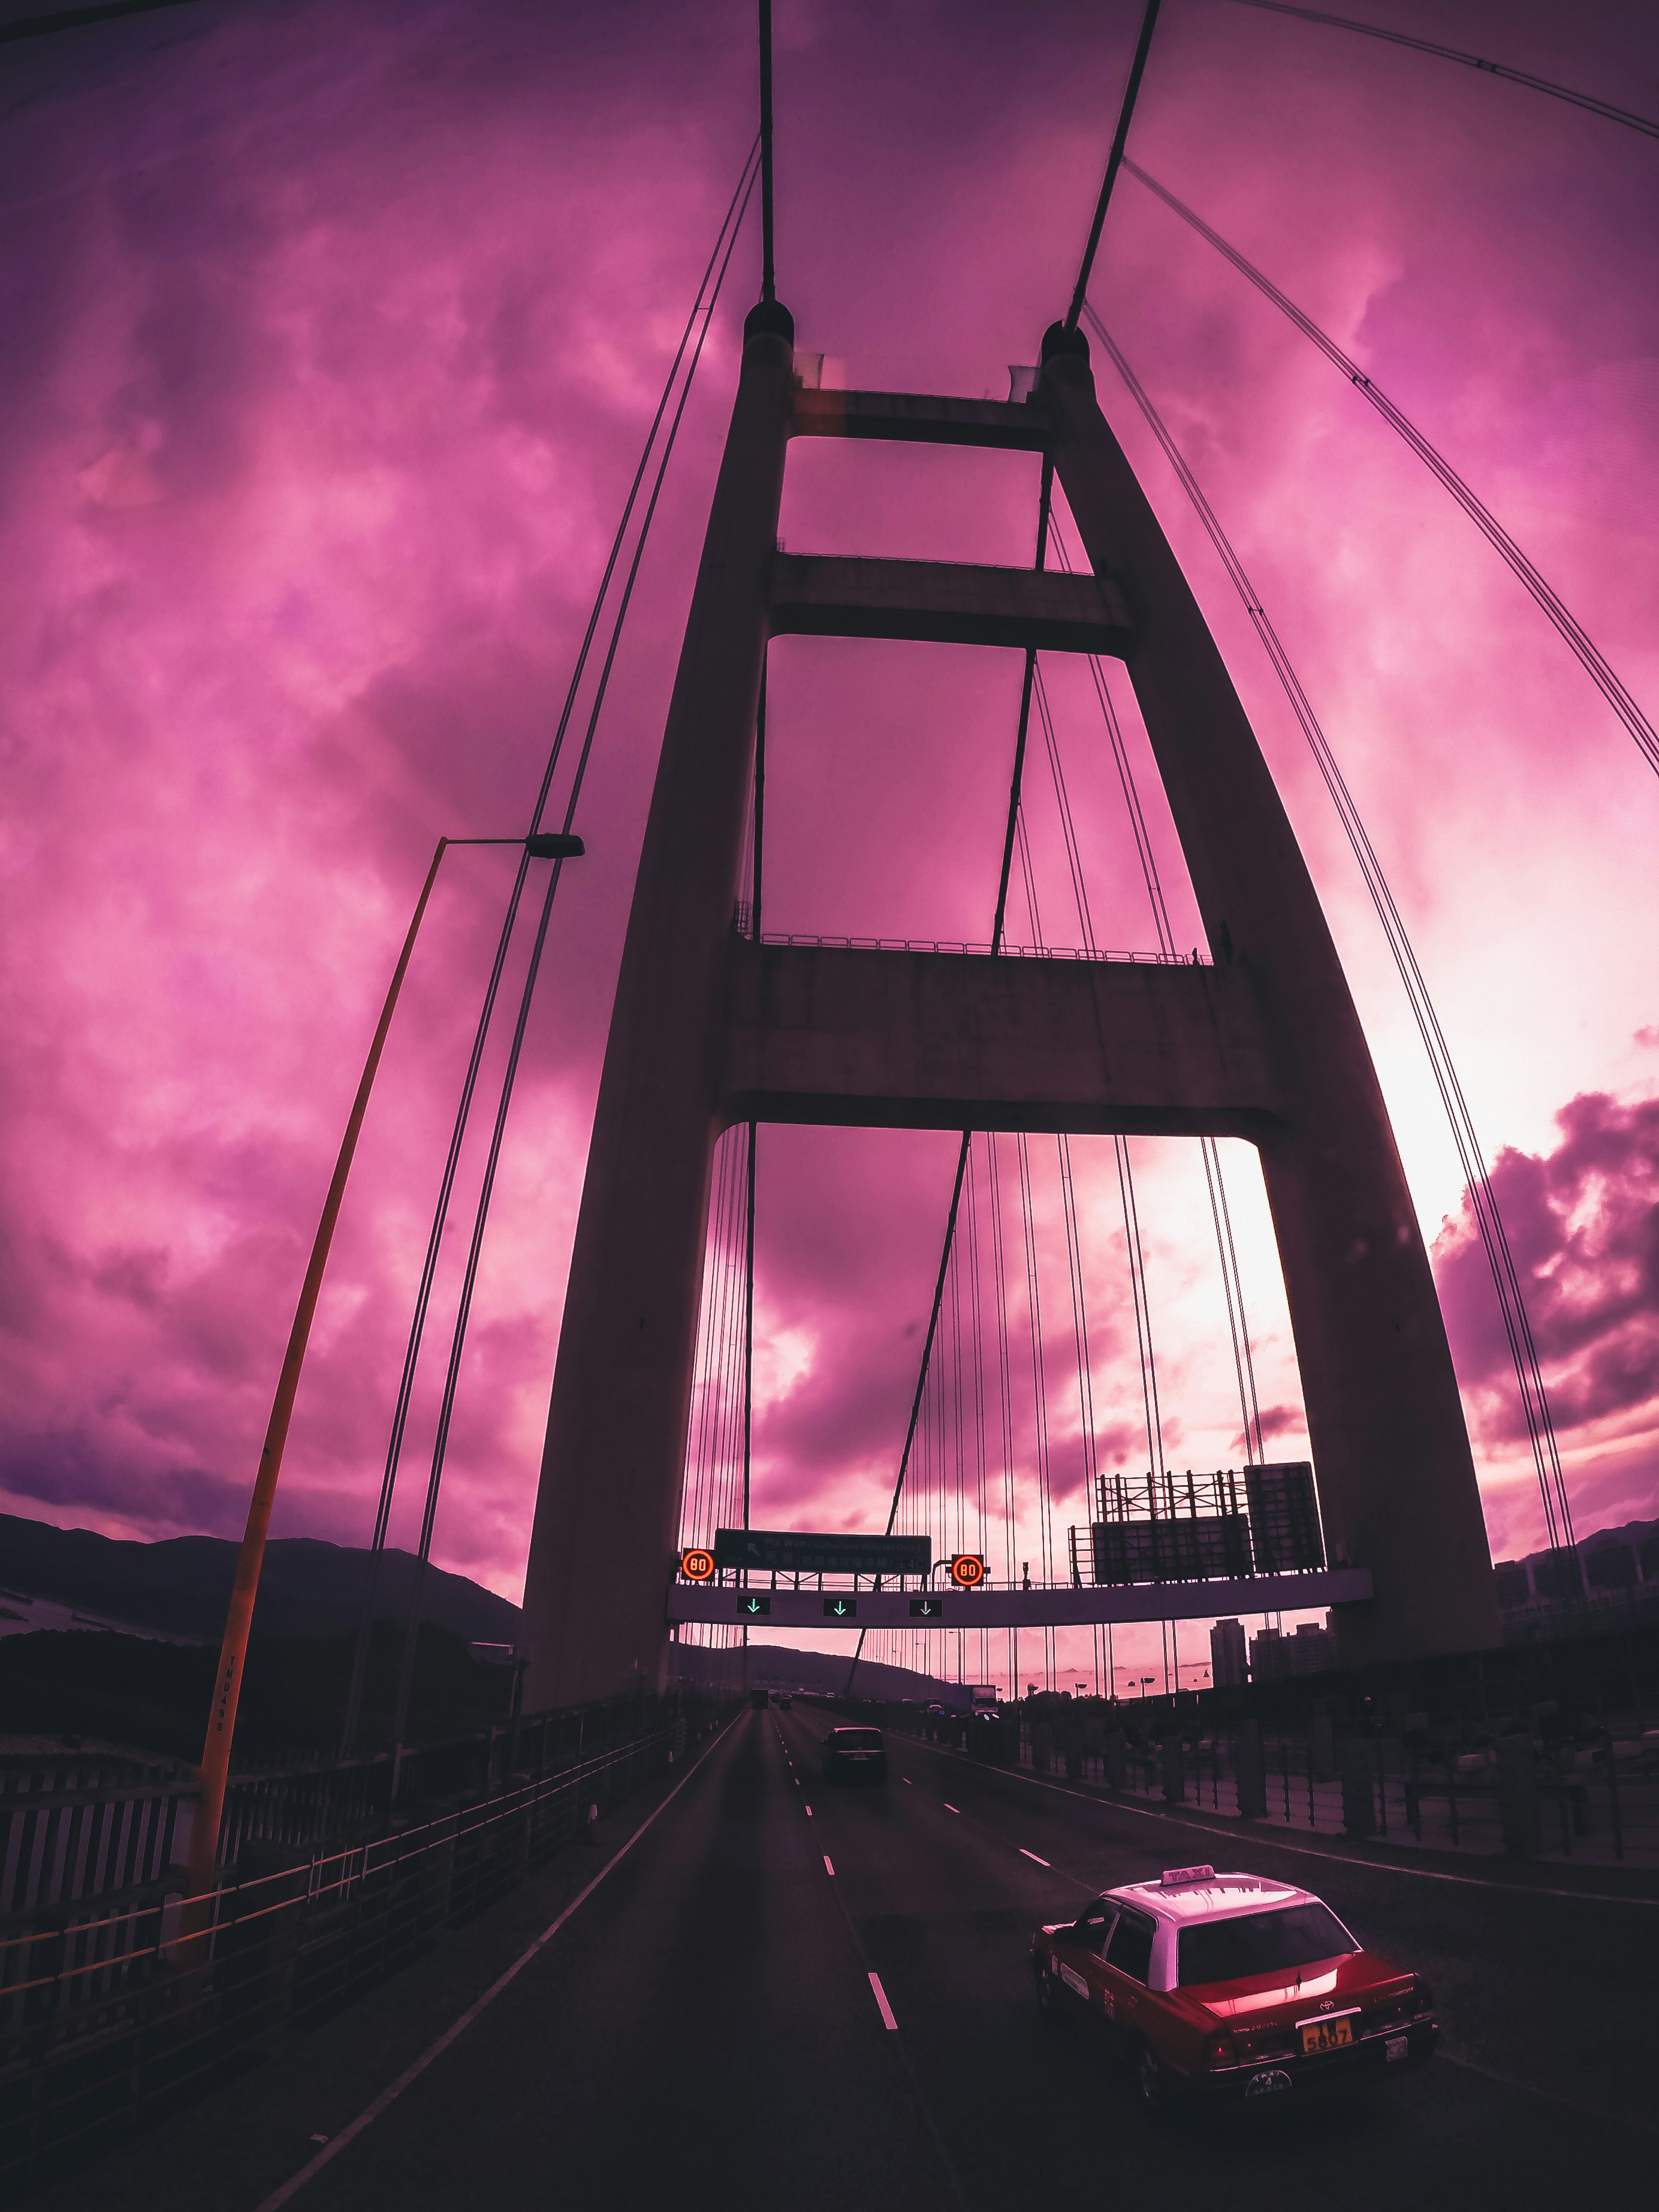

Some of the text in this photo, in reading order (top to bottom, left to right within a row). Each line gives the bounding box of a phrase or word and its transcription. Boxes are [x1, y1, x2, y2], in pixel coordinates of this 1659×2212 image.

[765, 1537, 780, 1546] Ma
[784, 1538, 806, 1547] Wan
[690, 1558, 706, 1571] 80
[907, 1559, 924, 1569] 4C
[961, 1564, 976, 1576] 80
[1169, 1867, 1210, 1882] TAXI
[1307, 2029, 1347, 2051] 5807
[1265, 2077, 1272, 2086] 4
